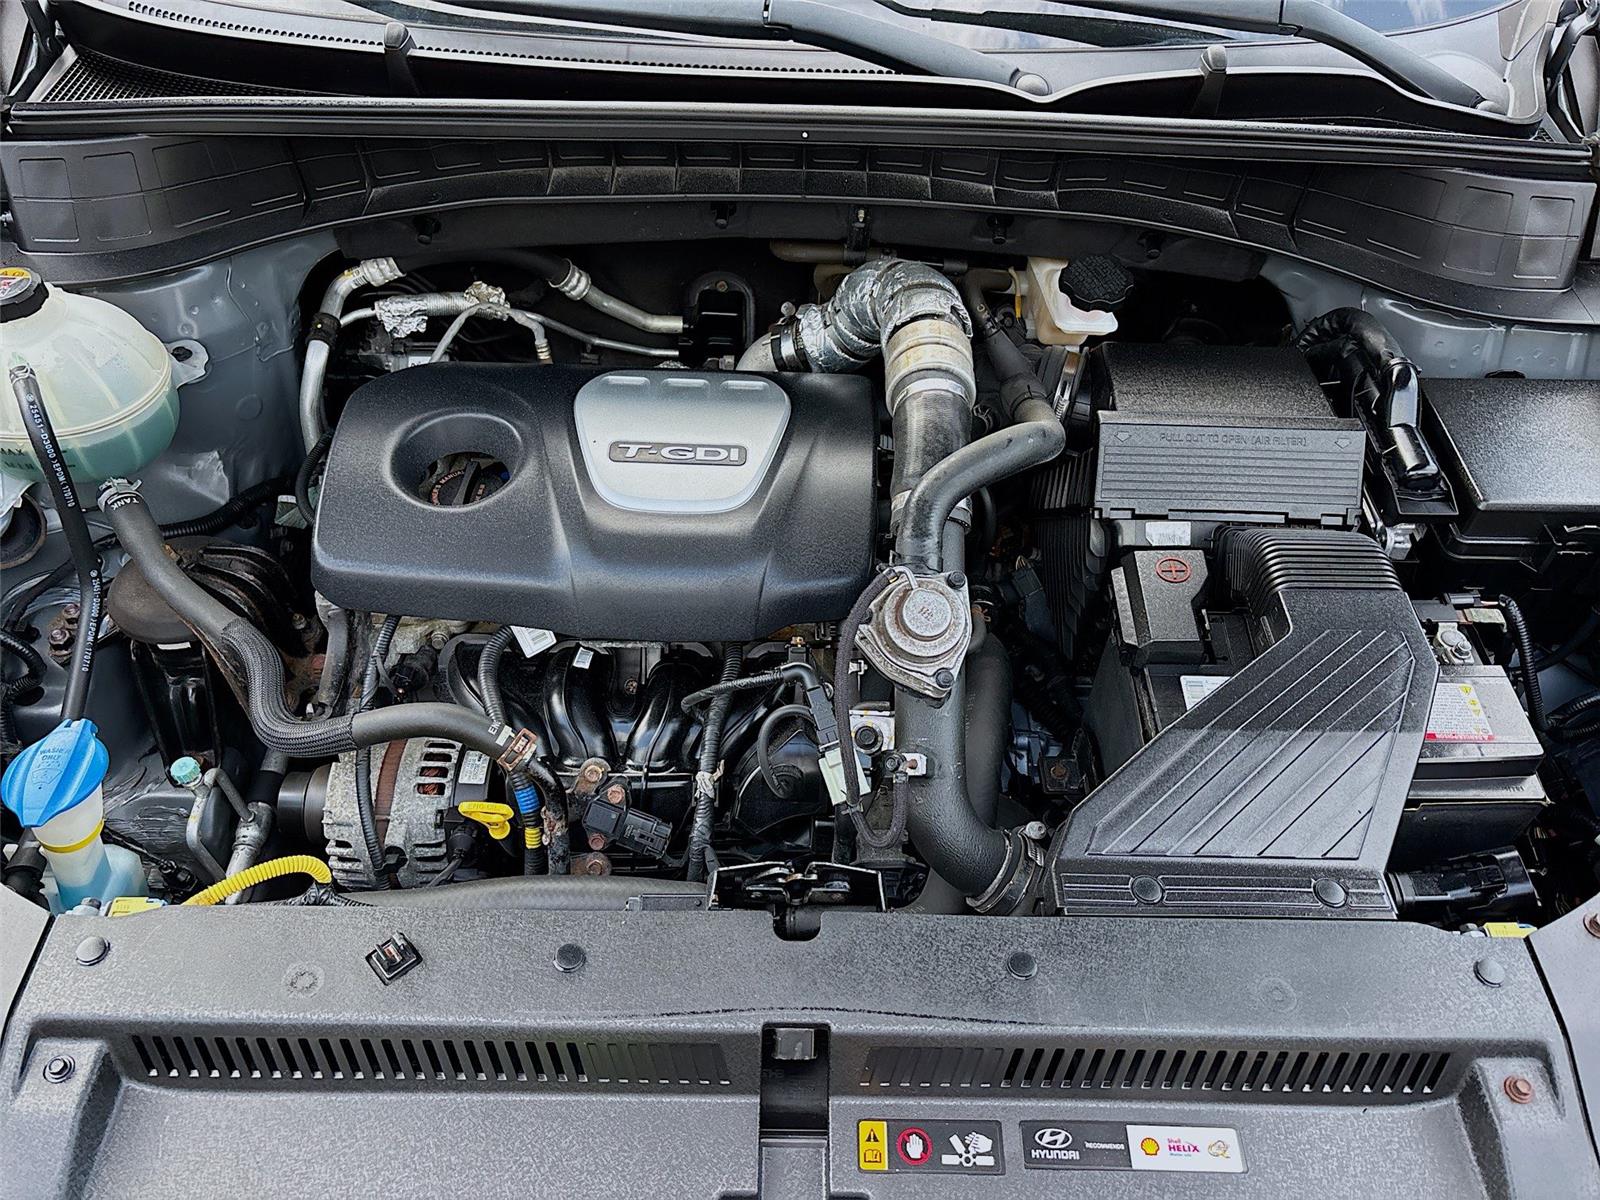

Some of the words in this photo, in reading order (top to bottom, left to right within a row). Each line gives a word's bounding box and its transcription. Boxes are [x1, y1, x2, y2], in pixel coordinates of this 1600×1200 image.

[1159, 433, 1183, 442] PULL
[1186, 433, 1205, 443] OUT
[1206, 433, 1219, 443] TO
[1222, 434, 1249, 444] OPEN
[30, 404, 56, 459] 25451-D3000
[62, 485, 75, 507] 170710
[617, 443, 740, 462] T-GDI
[110, 497, 140, 511] TANK
[81, 647, 93, 672] 170710
[1031, 1149, 1080, 1160] HYUNDAI
[1168, 1144, 1200, 1154] HELIX
